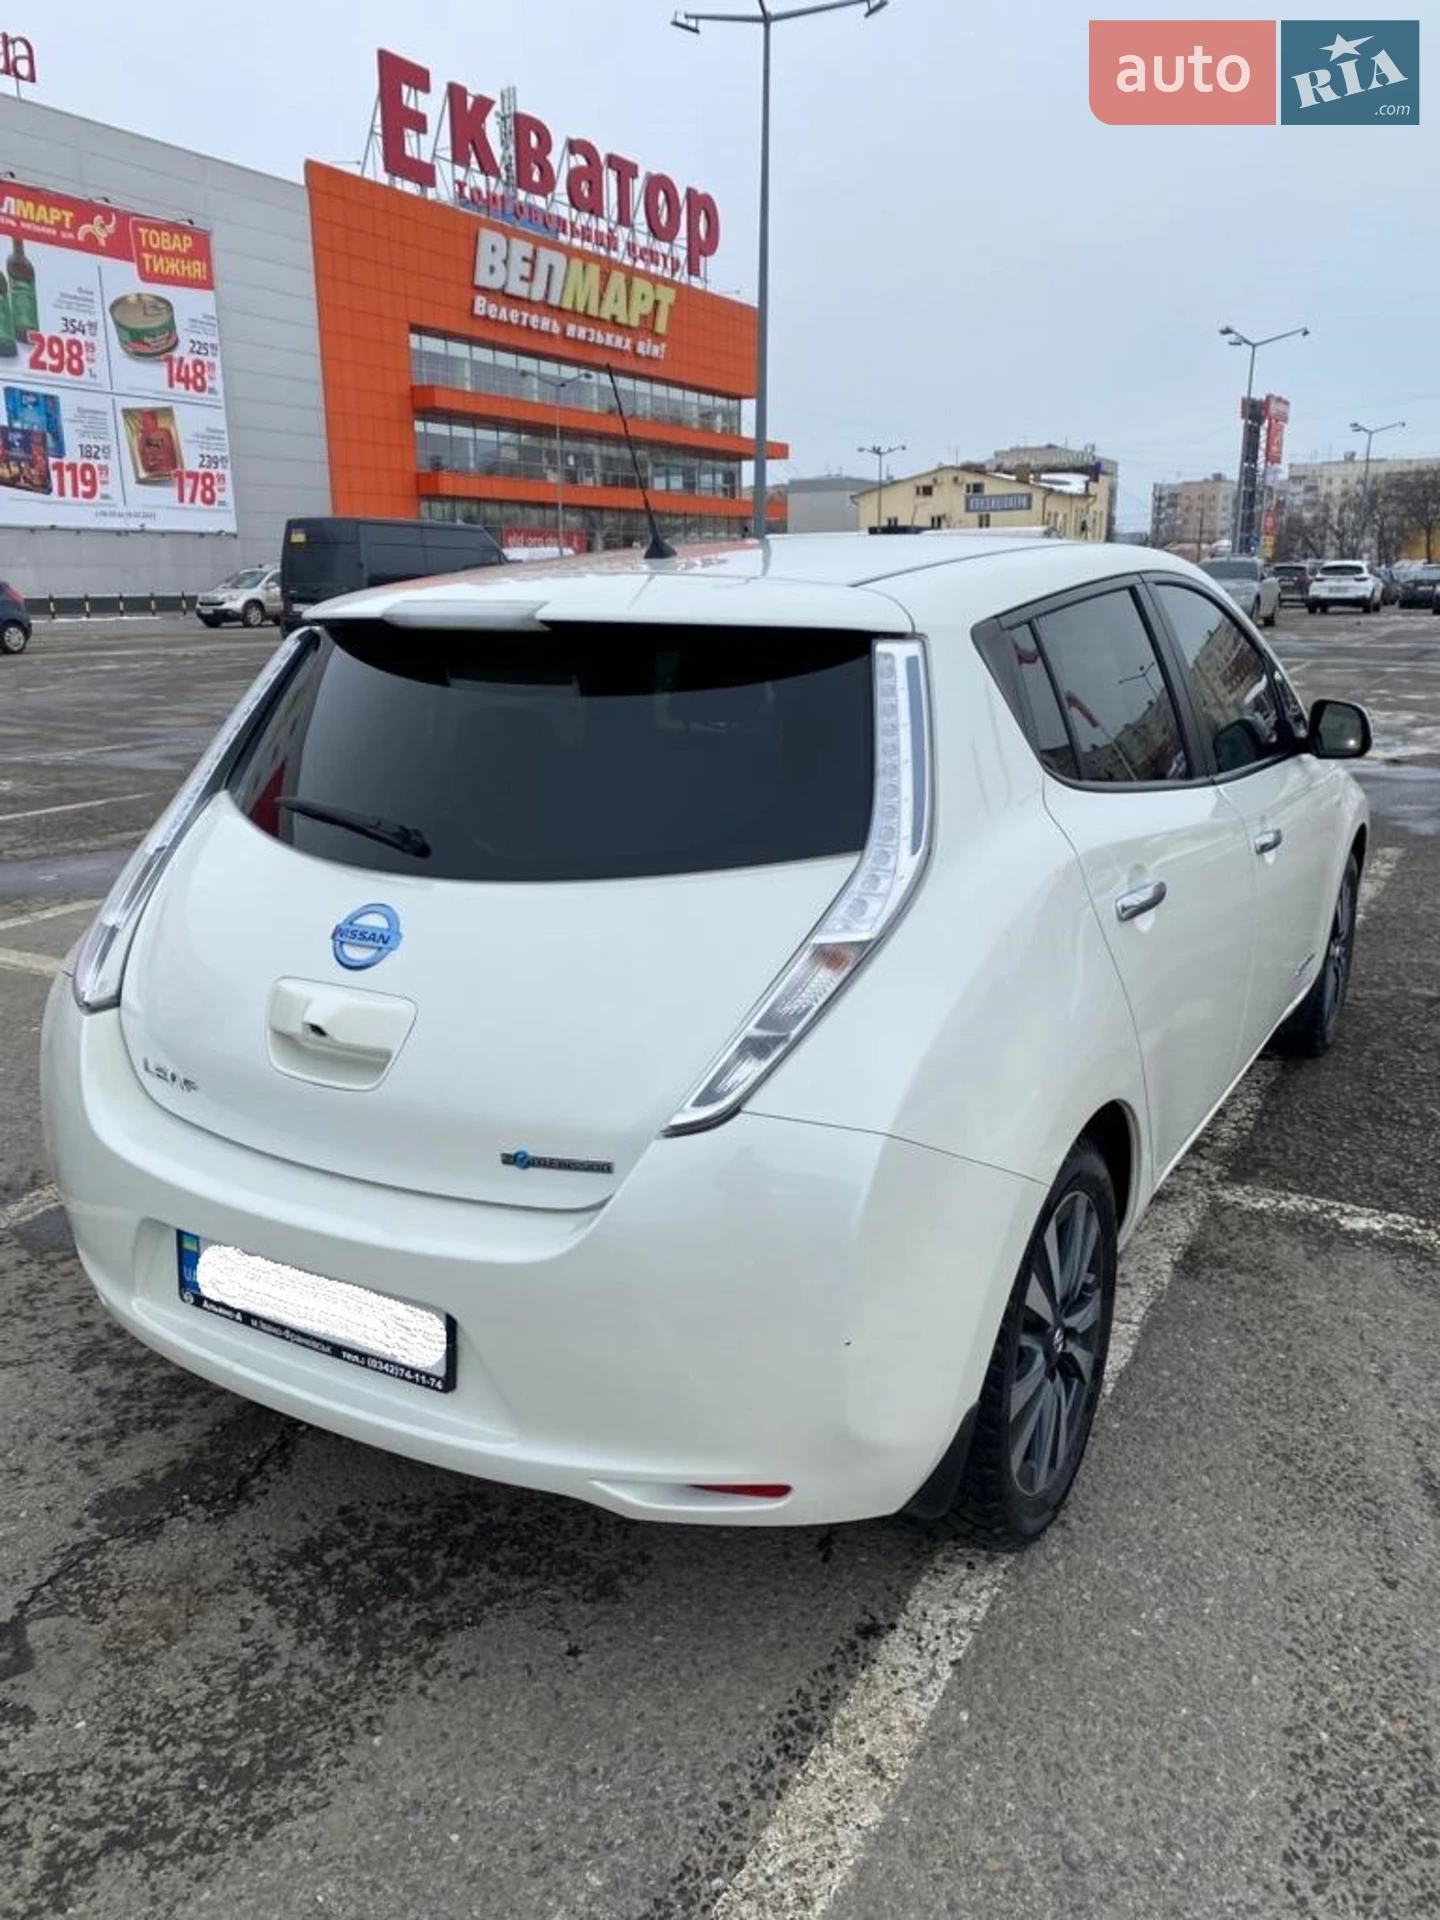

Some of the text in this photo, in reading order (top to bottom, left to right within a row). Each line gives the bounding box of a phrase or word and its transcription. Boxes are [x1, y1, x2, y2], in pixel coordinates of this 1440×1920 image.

[377, 47, 722, 277] Екватор
[137, 226, 193, 253] ТОВАР
[141, 251, 208, 281] ТИЖНЯ!
[473, 226, 676, 337] ВЕЛМАРТ
[473, 295, 667, 361] Велетень низьких цін!
[27, 332, 85, 378] 298
[162, 353, 208, 393] 148
[78, 443, 101, 460] 182
[198, 453, 219, 469] 239
[51, 460, 98, 500] 119
[173, 470, 217, 506] 178
[337, 926, 392, 946] NISSAN
